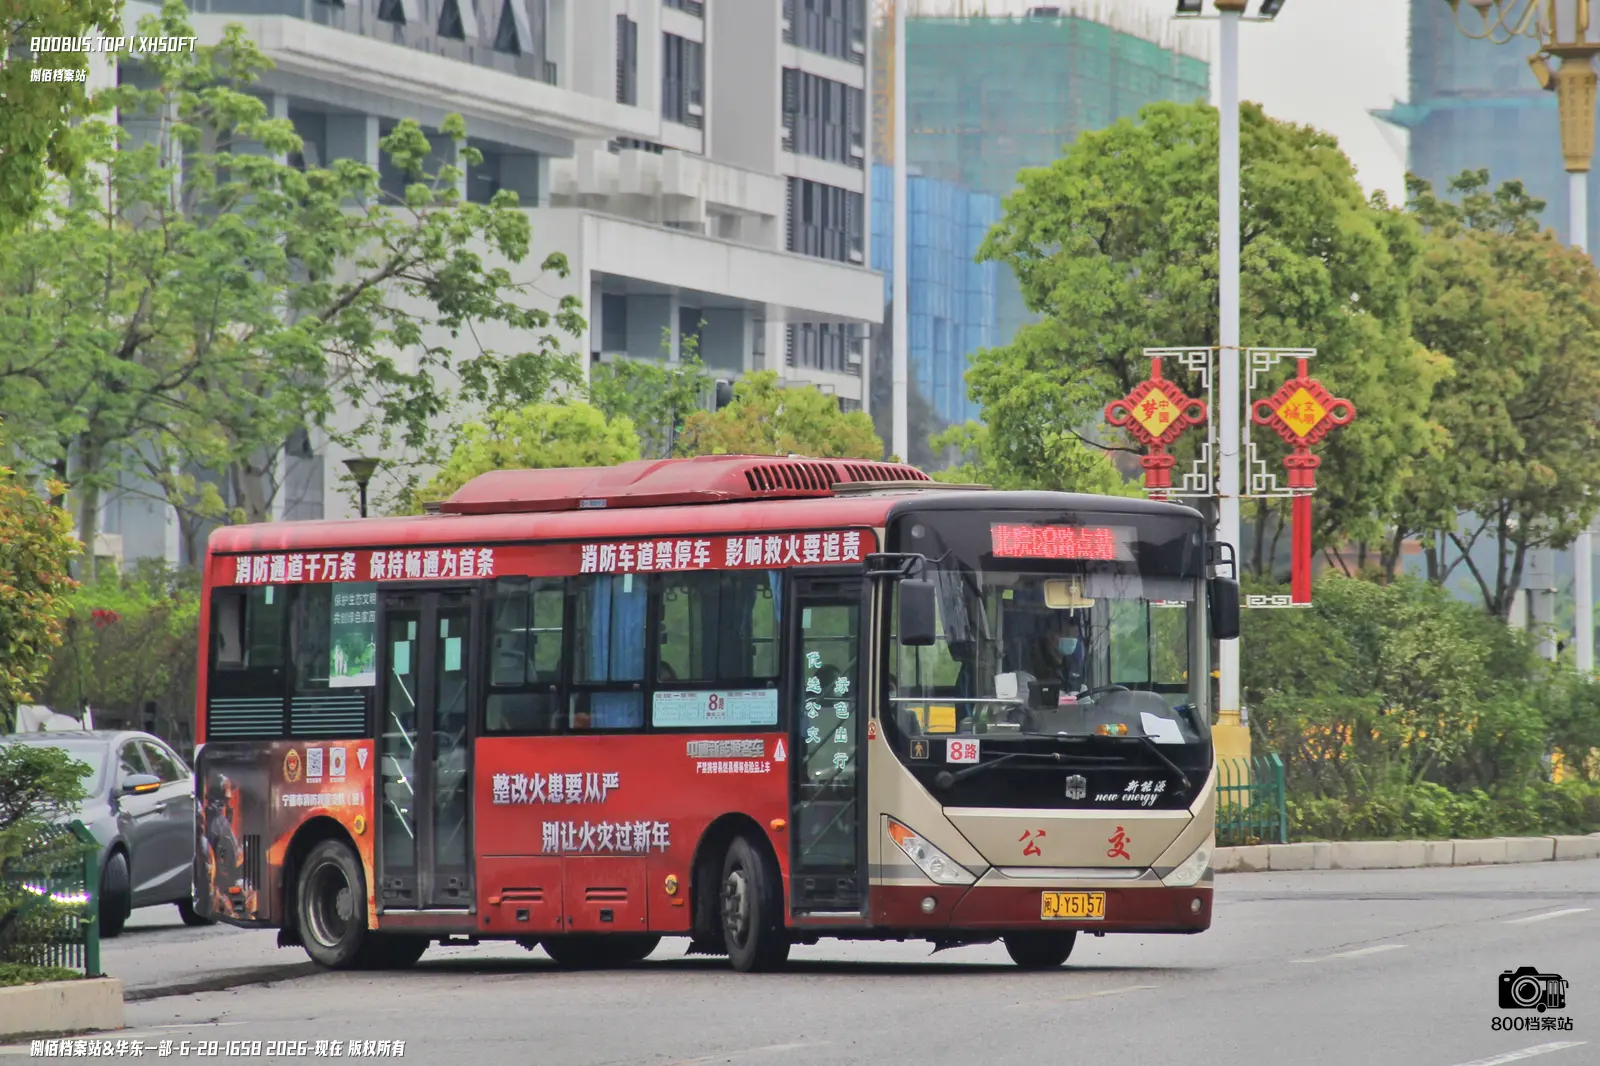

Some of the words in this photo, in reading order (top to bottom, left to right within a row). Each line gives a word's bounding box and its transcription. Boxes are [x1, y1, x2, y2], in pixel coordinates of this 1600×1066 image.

[235, 553, 356, 583] 消防通道千万条
[369, 549, 494, 579] 保持畅通为首条
[580, 540, 711, 573] 消防车道禁停车
[725, 531, 860, 566] 影响救火要追责
[832, 676, 850, 770] 绿色出行
[951, 741, 977, 760] 8路
[492, 772, 619, 804] 整改火患要从严
[1094, 793, 1118, 802] new
[1121, 793, 1158, 807] energy
[1124, 780, 1167, 793] 新能源
[541, 820, 671, 853] 别让火灾过新年
